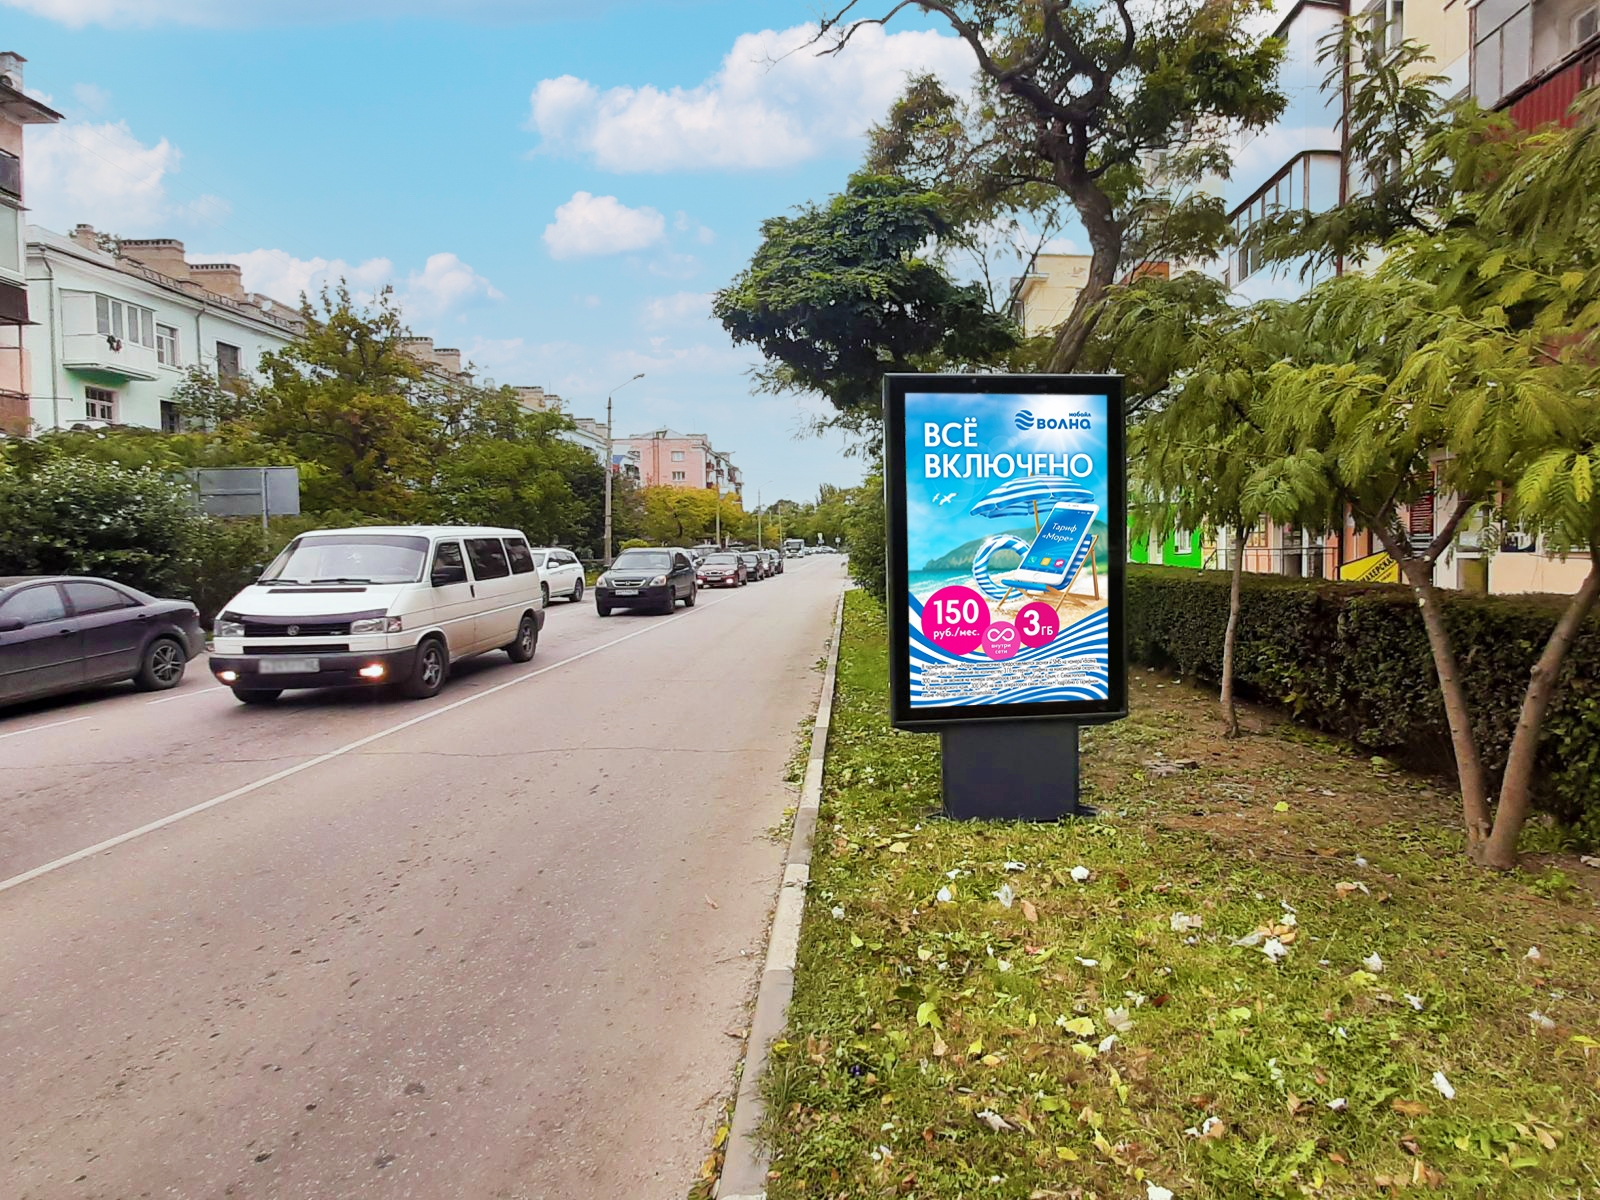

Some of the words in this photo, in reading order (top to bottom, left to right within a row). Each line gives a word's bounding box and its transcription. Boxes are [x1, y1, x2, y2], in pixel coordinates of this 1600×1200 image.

[924, 416, 978, 447] ВСЁ
[924, 452, 1094, 479] ВКЛЮЧЕНО
[1052, 522, 1077, 534] Тариф
[933, 598, 980, 625] 150
[933, 626, 980, 641] руб./мес.
[991, 643, 1012, 651] внутри
